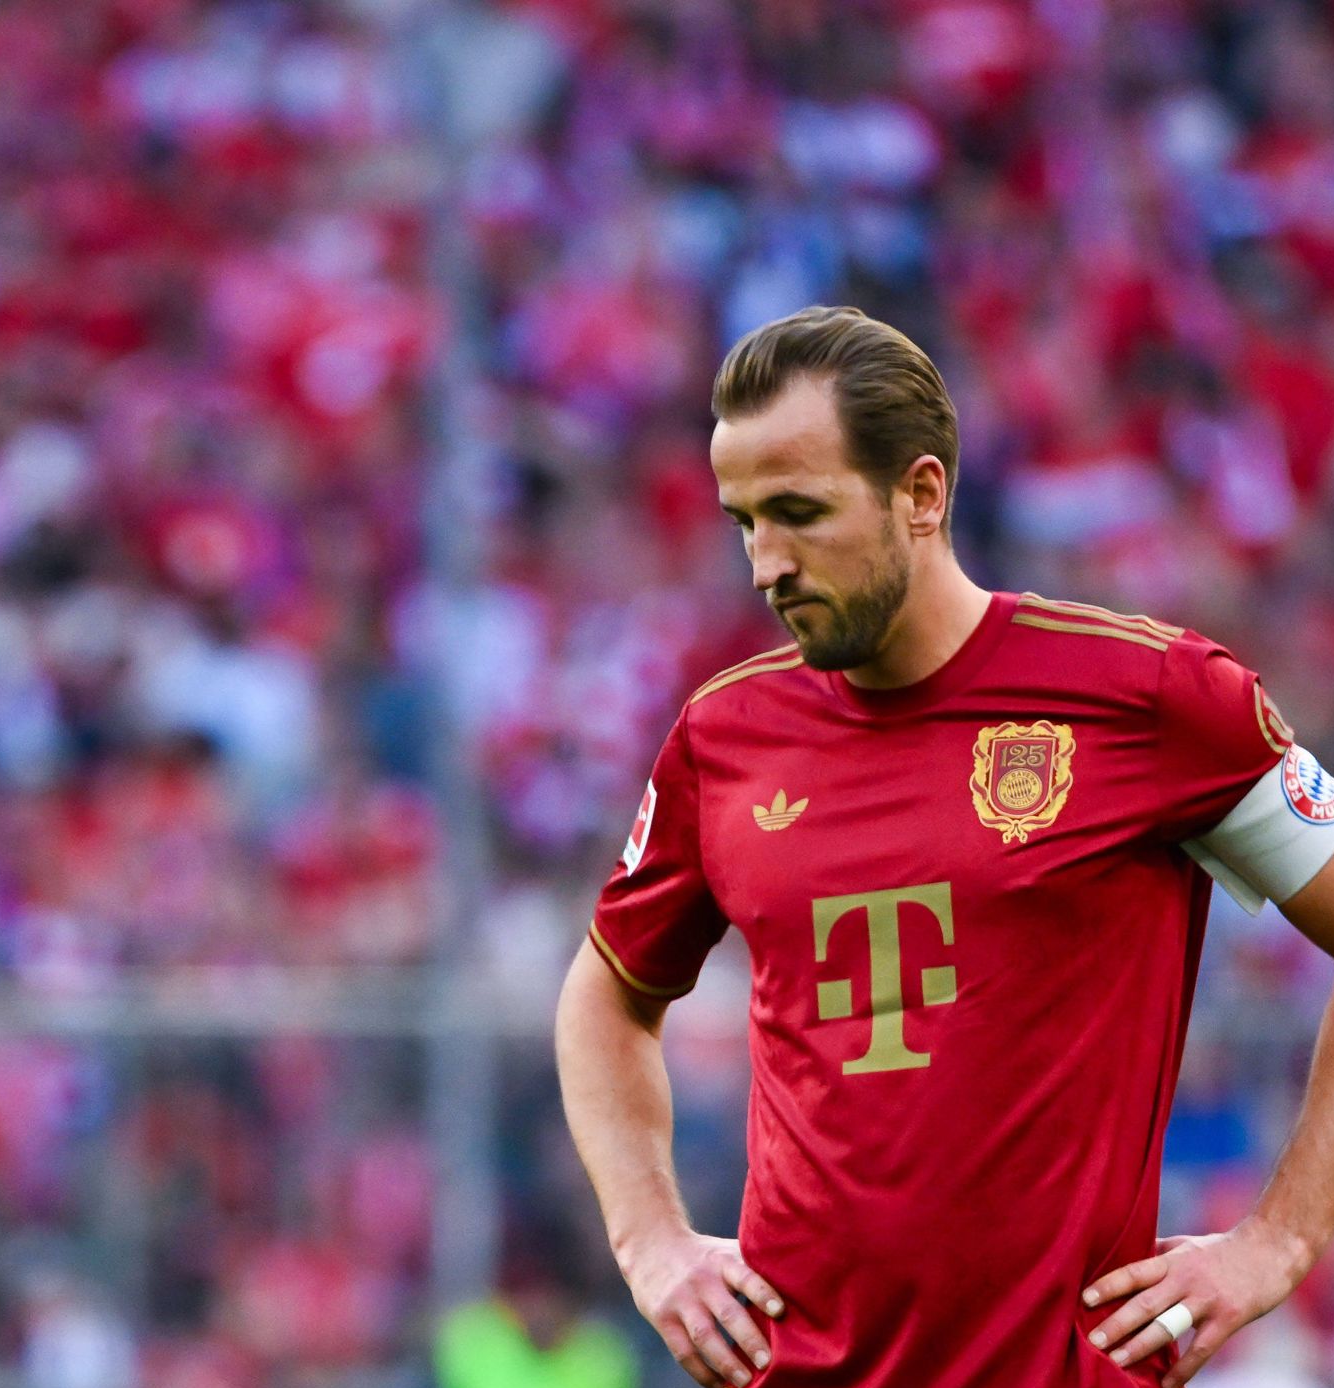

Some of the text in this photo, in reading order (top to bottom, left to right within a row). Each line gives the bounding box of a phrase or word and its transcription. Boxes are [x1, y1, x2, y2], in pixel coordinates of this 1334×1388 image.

[1000, 745, 1046, 767] 125
[1286, 777, 1304, 802] FC
[812, 881, 956, 1075] T
